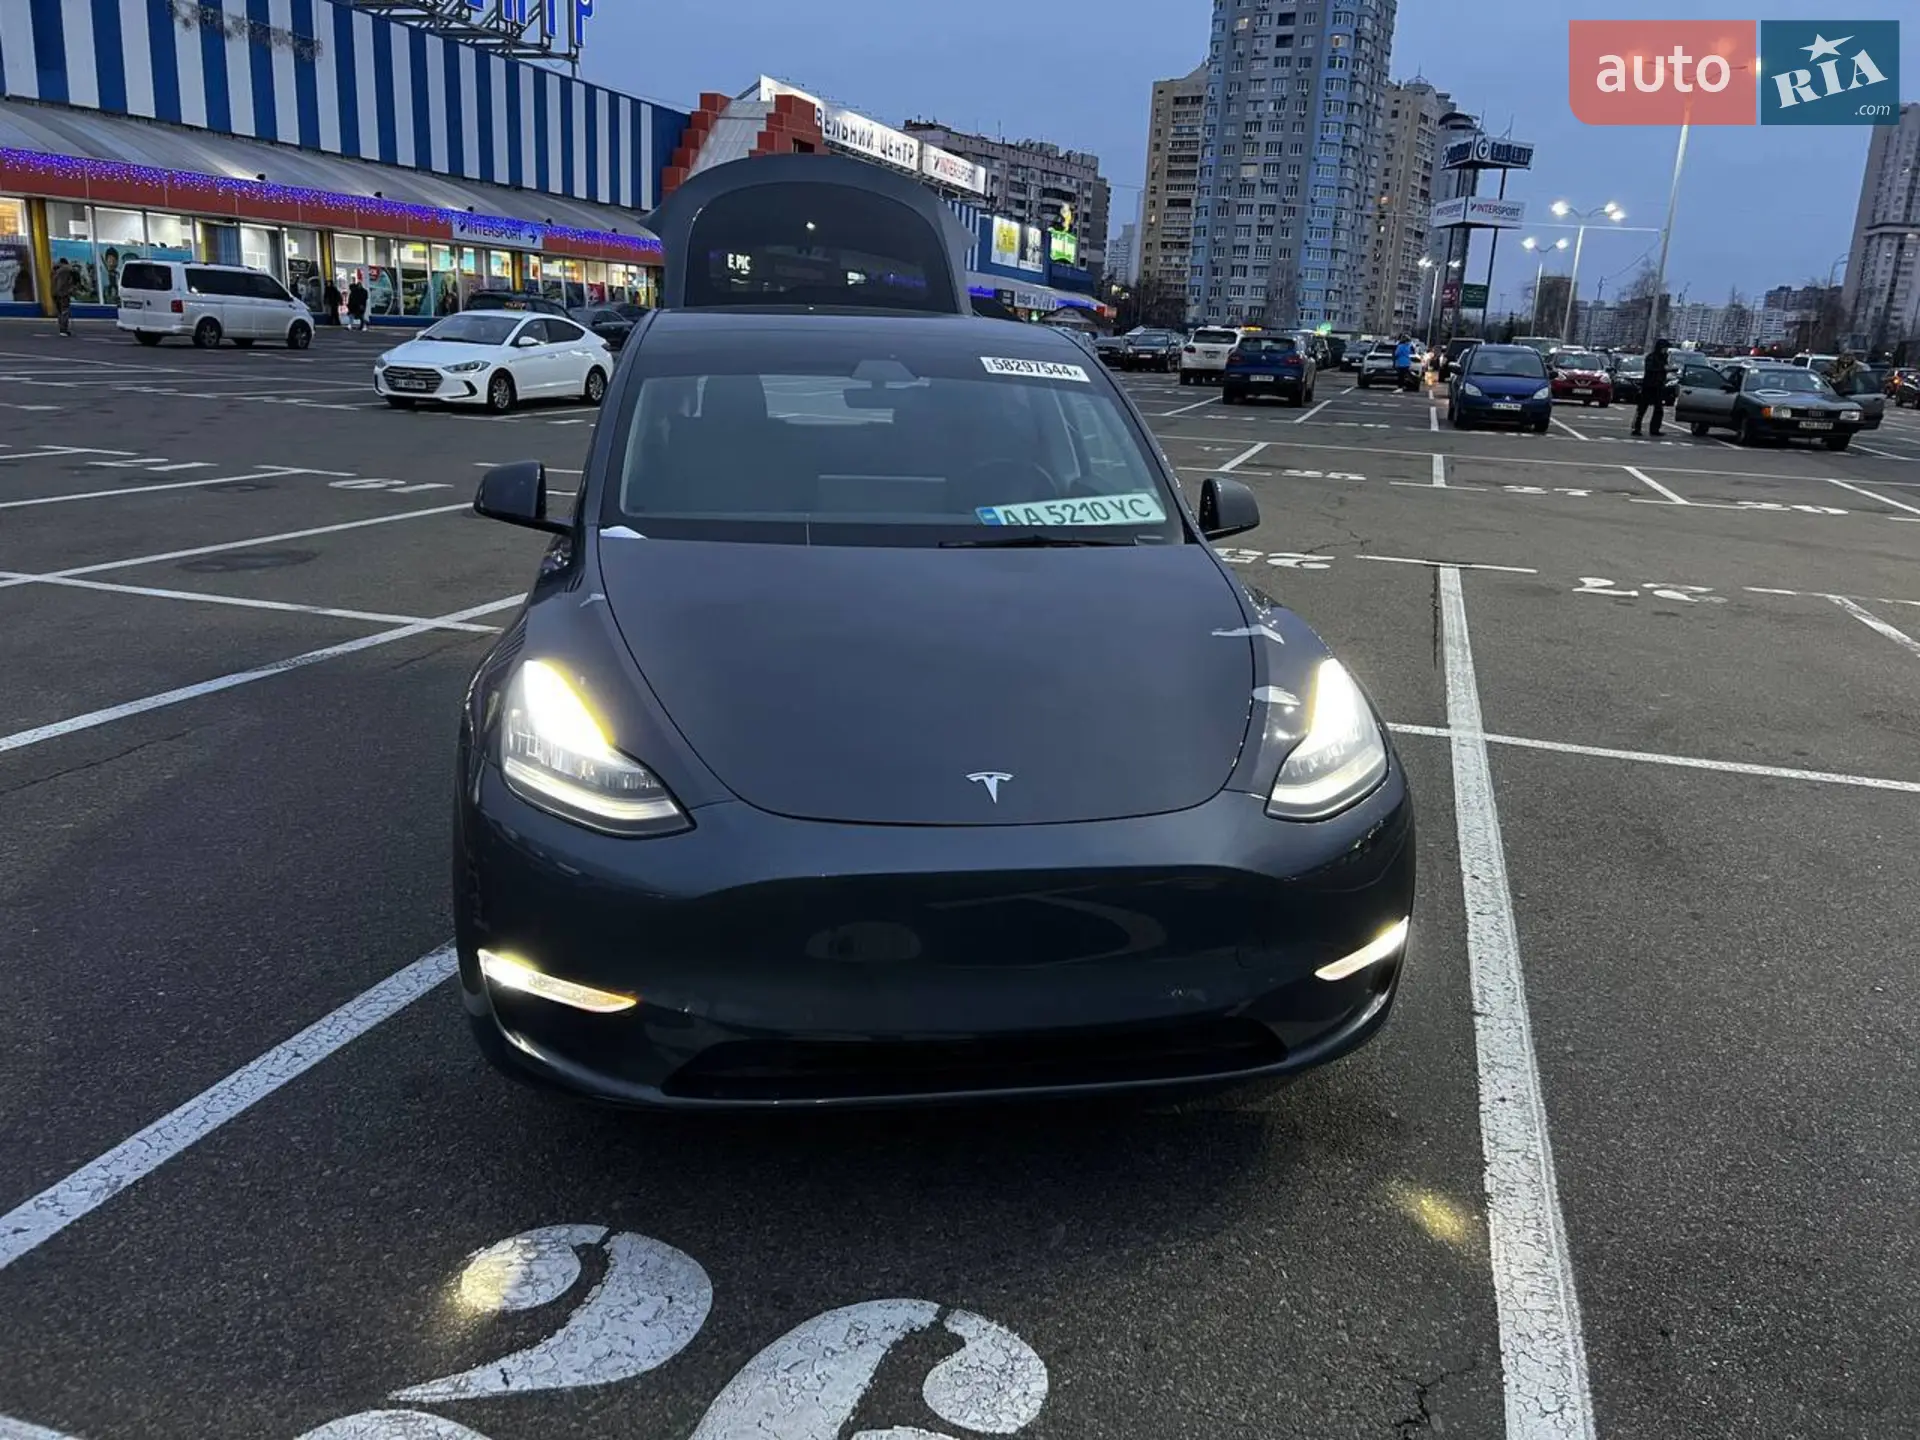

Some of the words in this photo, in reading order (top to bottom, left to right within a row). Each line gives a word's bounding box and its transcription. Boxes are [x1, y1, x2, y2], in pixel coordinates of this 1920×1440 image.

[880, 135, 914, 165] ЦЕНТР
[1476, 204, 1520, 216] INTERSPORT
[467, 222, 521, 241] INTERSPORT
[1002, 508, 1046, 525] AA
[1048, 502, 1111, 526] 5210
[1108, 499, 1151, 520] YC
